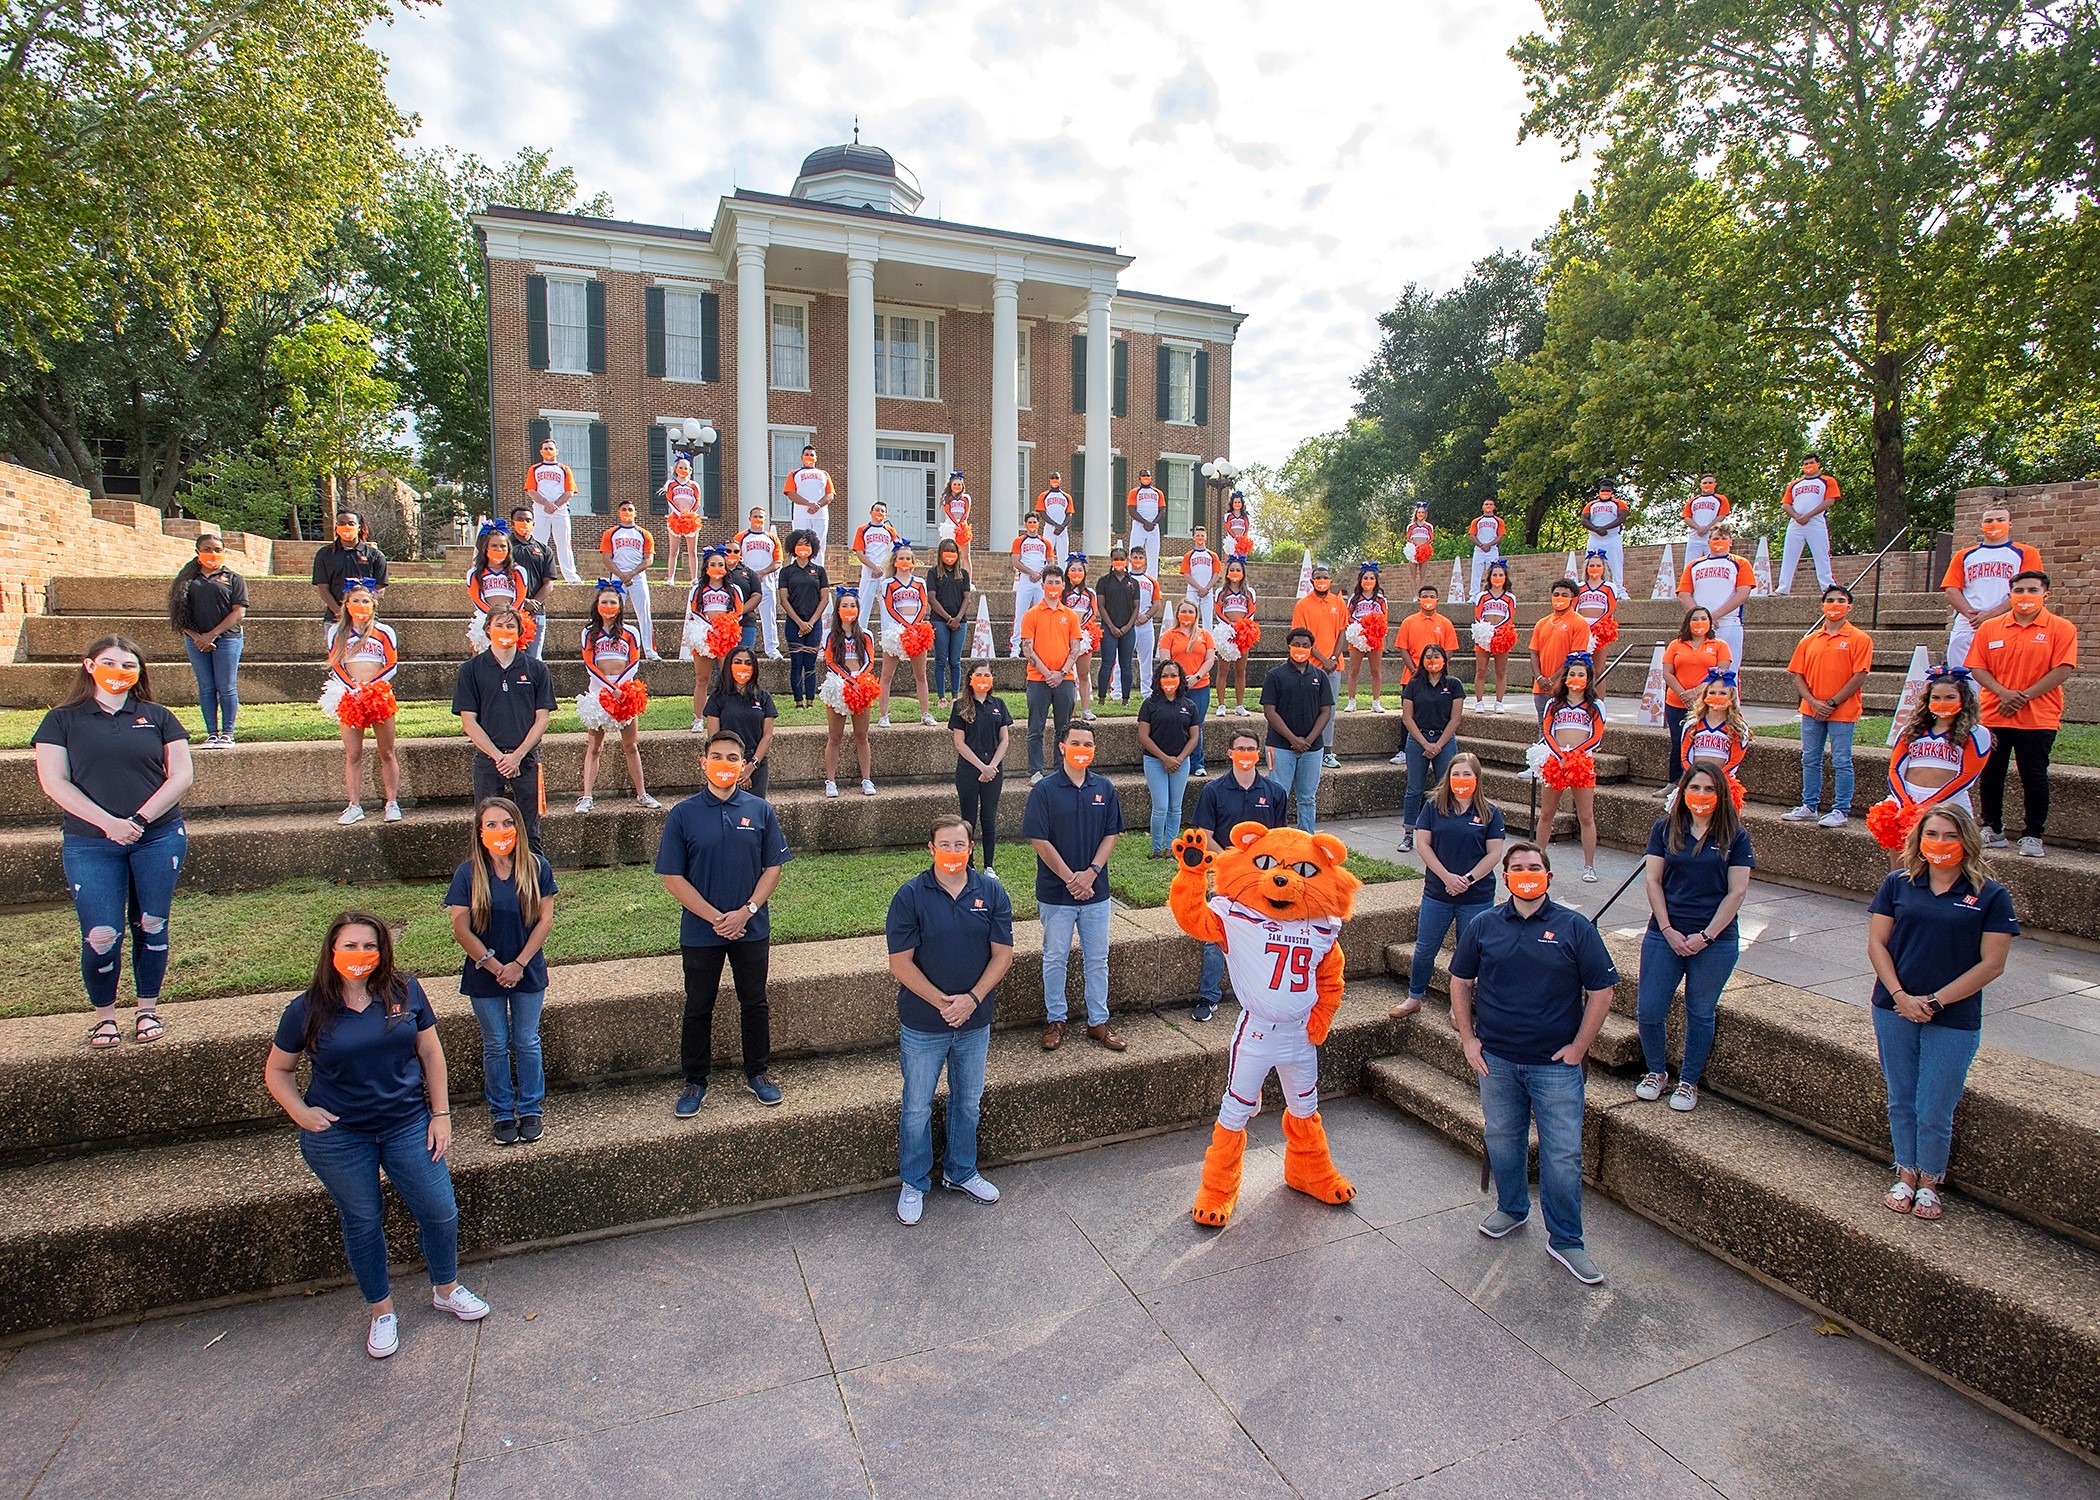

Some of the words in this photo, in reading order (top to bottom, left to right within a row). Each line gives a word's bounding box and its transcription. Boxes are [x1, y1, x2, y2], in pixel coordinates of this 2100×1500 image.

[1795, 485, 1820, 497] BEARKATS
[1695, 566, 1730, 581] BEARKATS
[1967, 561, 2014, 581] BEARKATS
[1268, 933, 1282, 942] SAM
[1284, 934, 1310, 945] HOUSTON
[1264, 942, 1314, 992] 79
